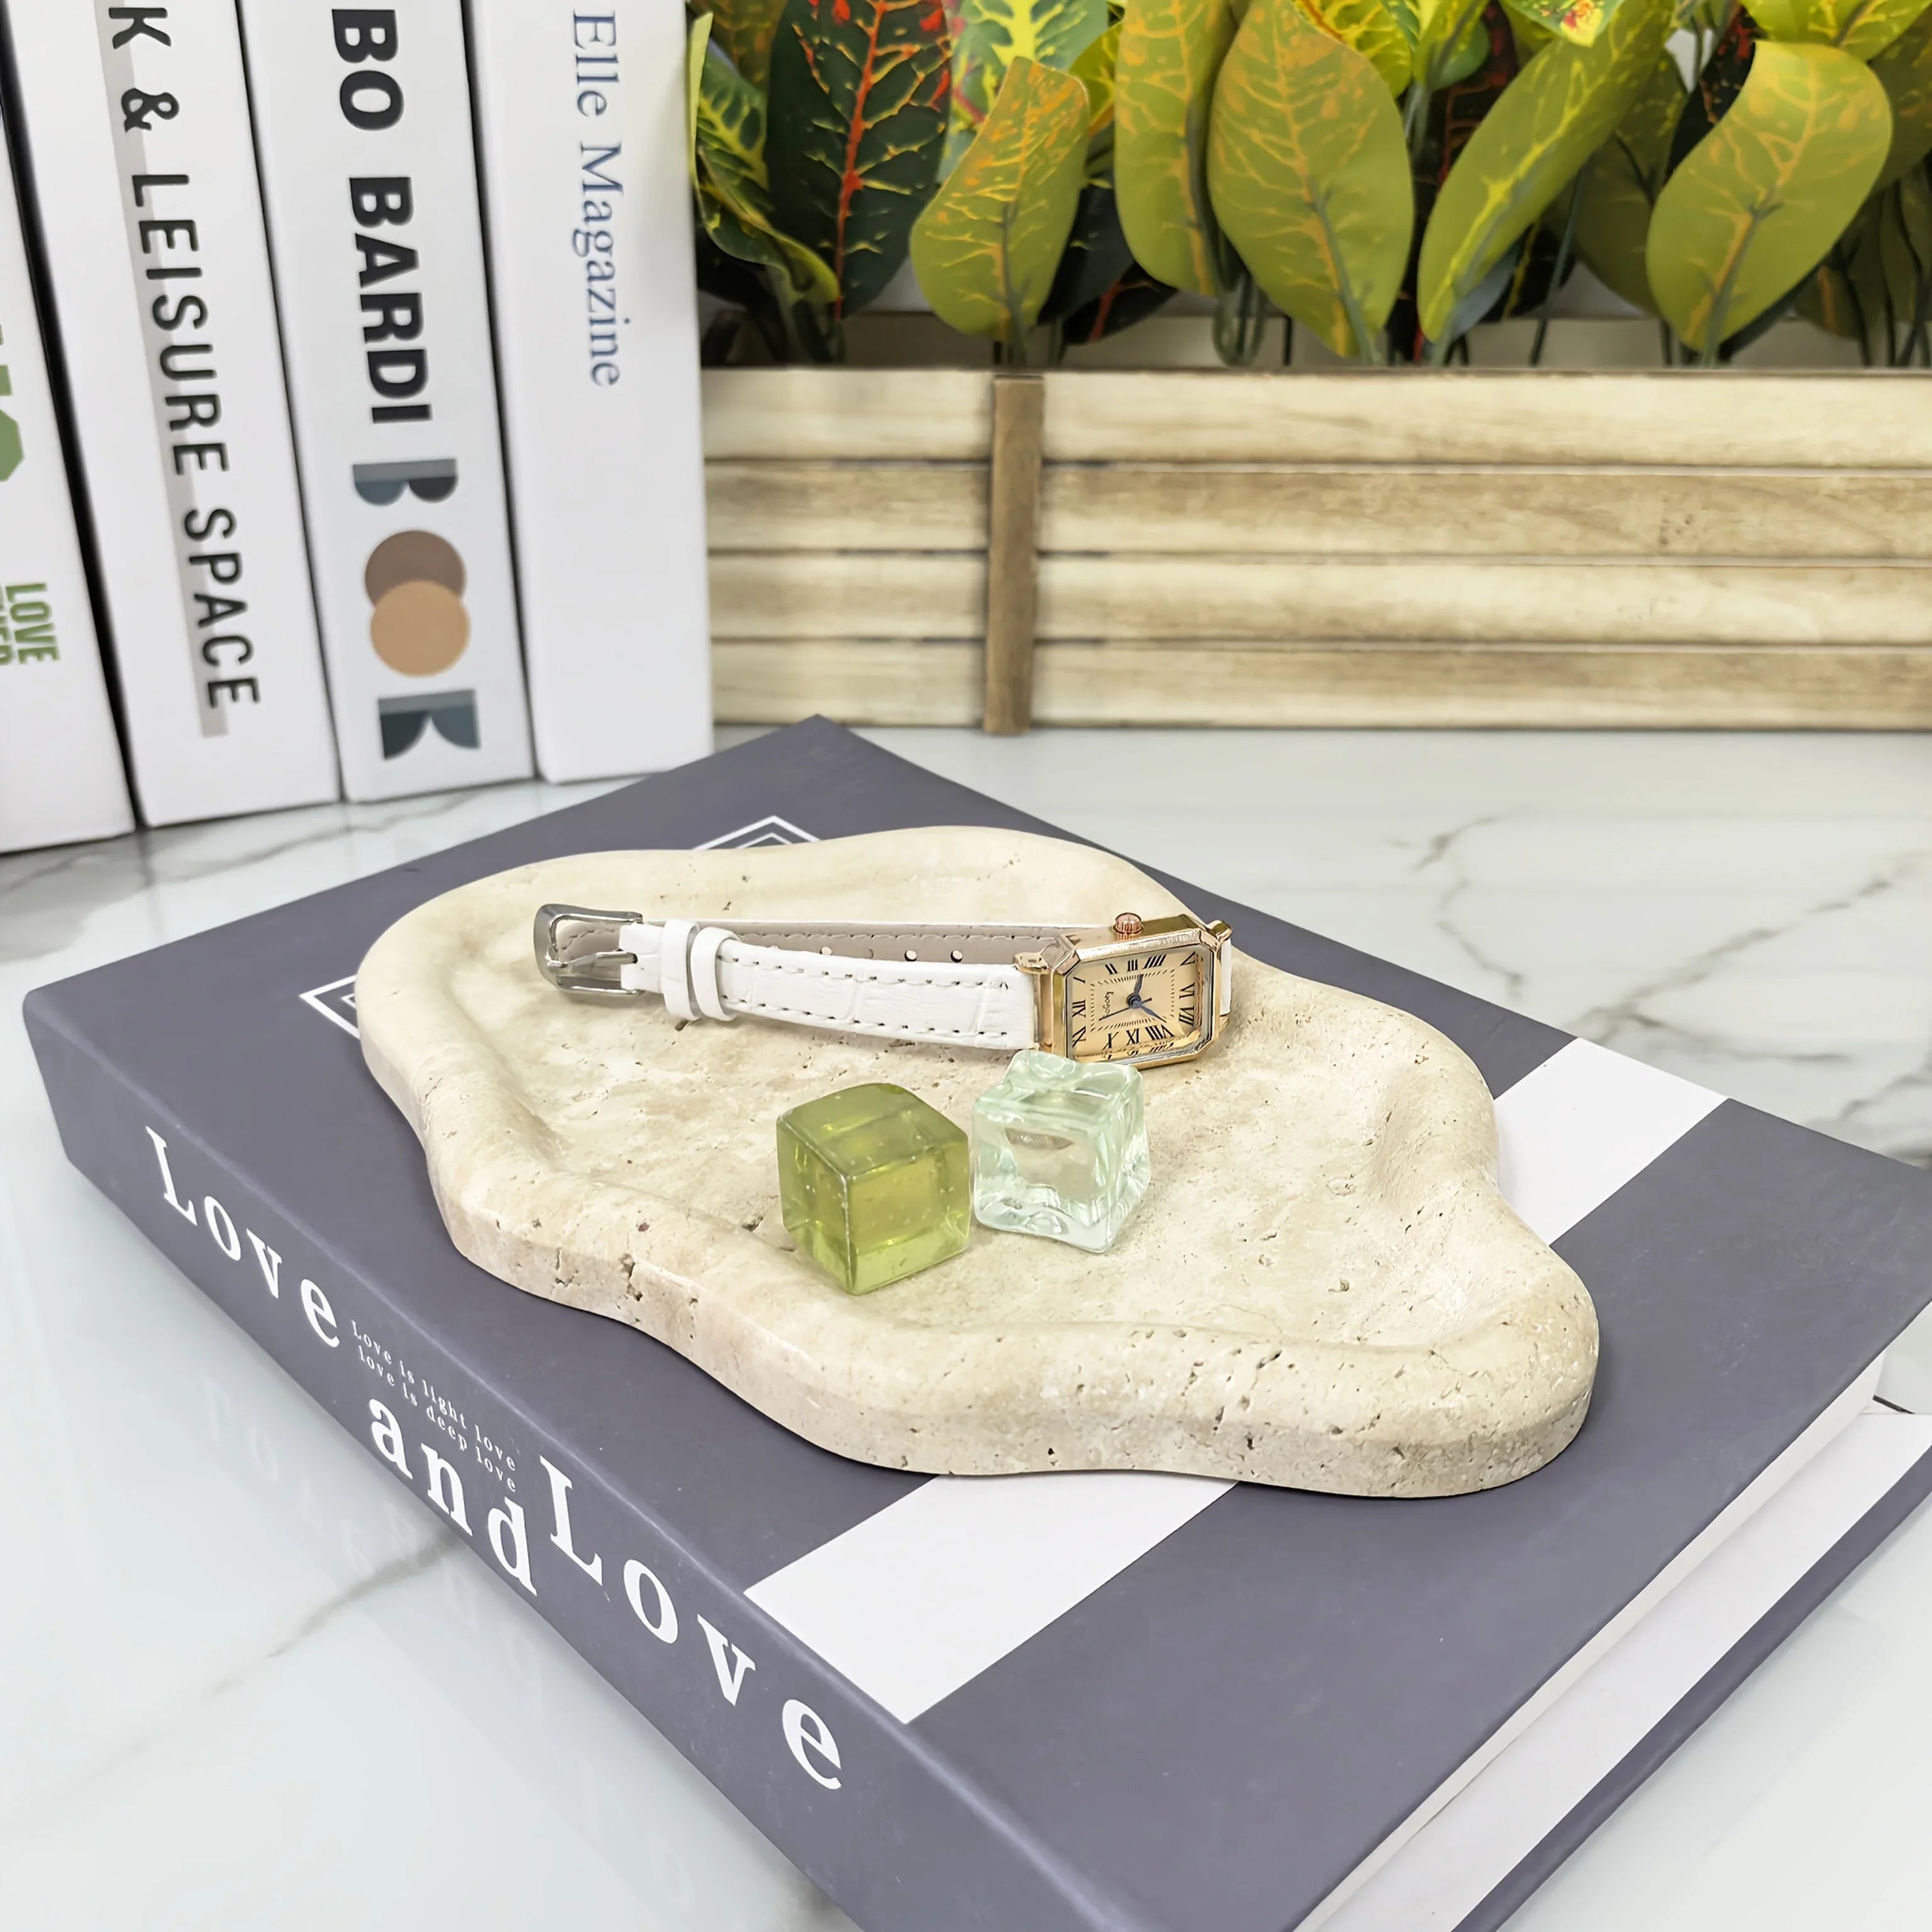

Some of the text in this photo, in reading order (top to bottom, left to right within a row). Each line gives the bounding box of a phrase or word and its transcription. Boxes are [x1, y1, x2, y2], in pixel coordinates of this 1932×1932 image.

[121, 88, 179, 132] &
[572, 10, 631, 387] Elle Magazine
[332, 9, 432, 424] BO BARDI
[132, 174, 230, 476] LEISURE
[5, 582, 61, 665] LOVE
[184, 508, 260, 709] SPACE
[145, 1126, 340, 1348] Love
[352, 1319, 516, 1471] Love is light love
[358, 1345, 516, 1492] love is deep love
[369, 1398, 538, 1597] and
[540, 1454, 842, 1790] Love
